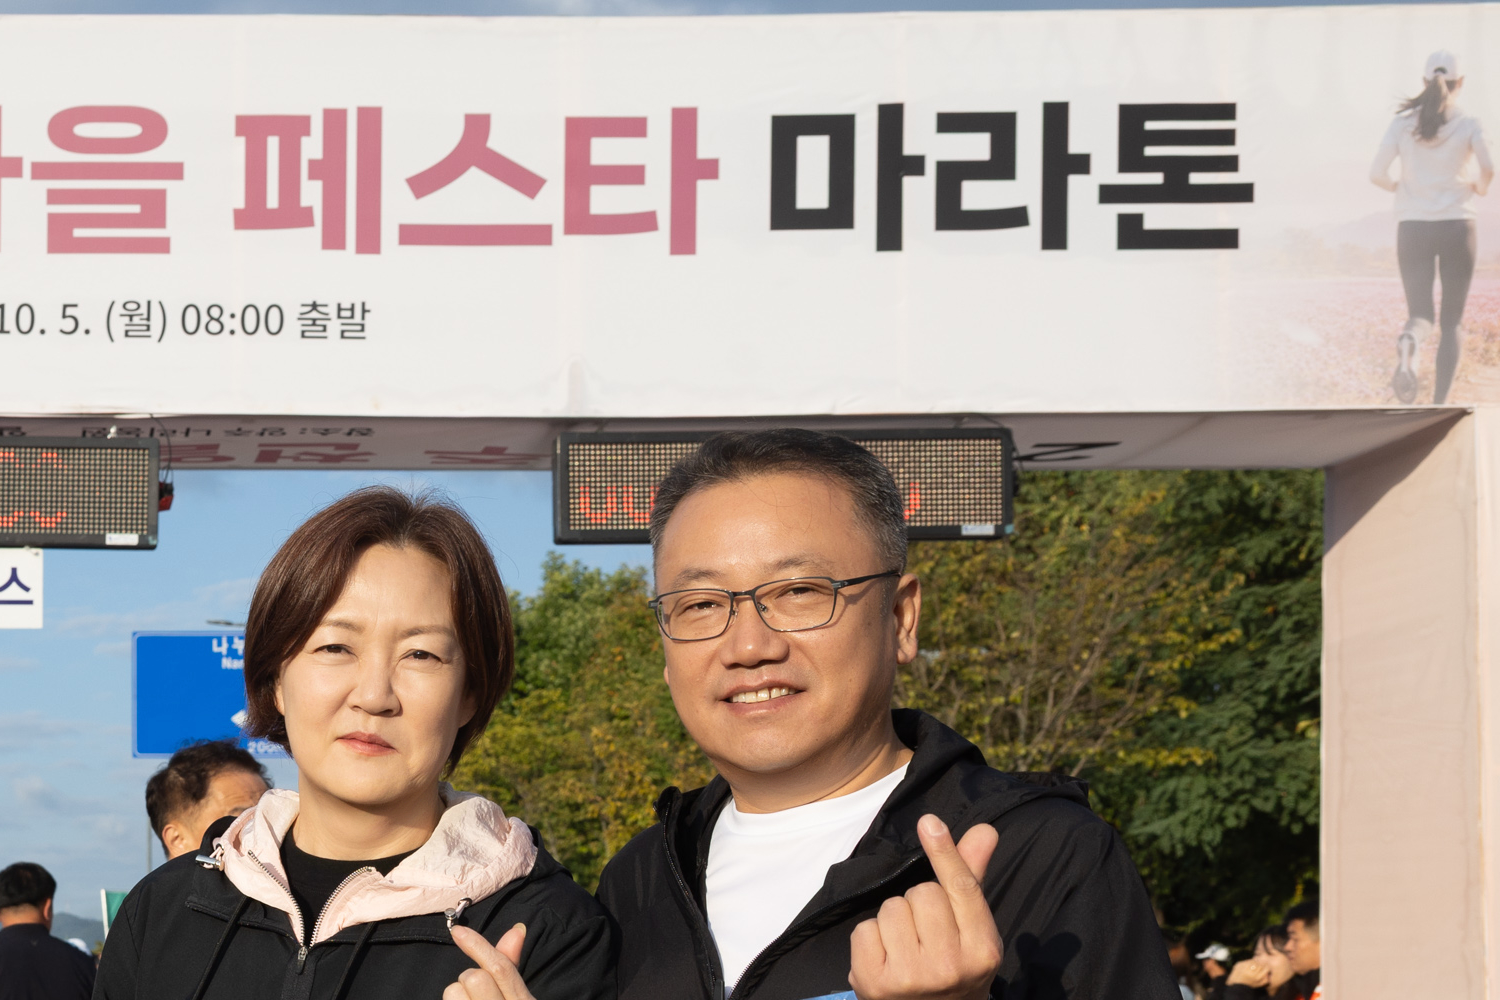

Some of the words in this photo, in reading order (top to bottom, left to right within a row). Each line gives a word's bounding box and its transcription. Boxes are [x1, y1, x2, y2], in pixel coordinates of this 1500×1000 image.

[233, 107, 719, 255] 페스타
[771, 102, 1253, 251] 마라톤
[60, 304, 90, 335] 5.
[107, 300, 166, 342] (월)
[182, 304, 284, 335] 08:00
[298, 301, 370, 339] 출발
